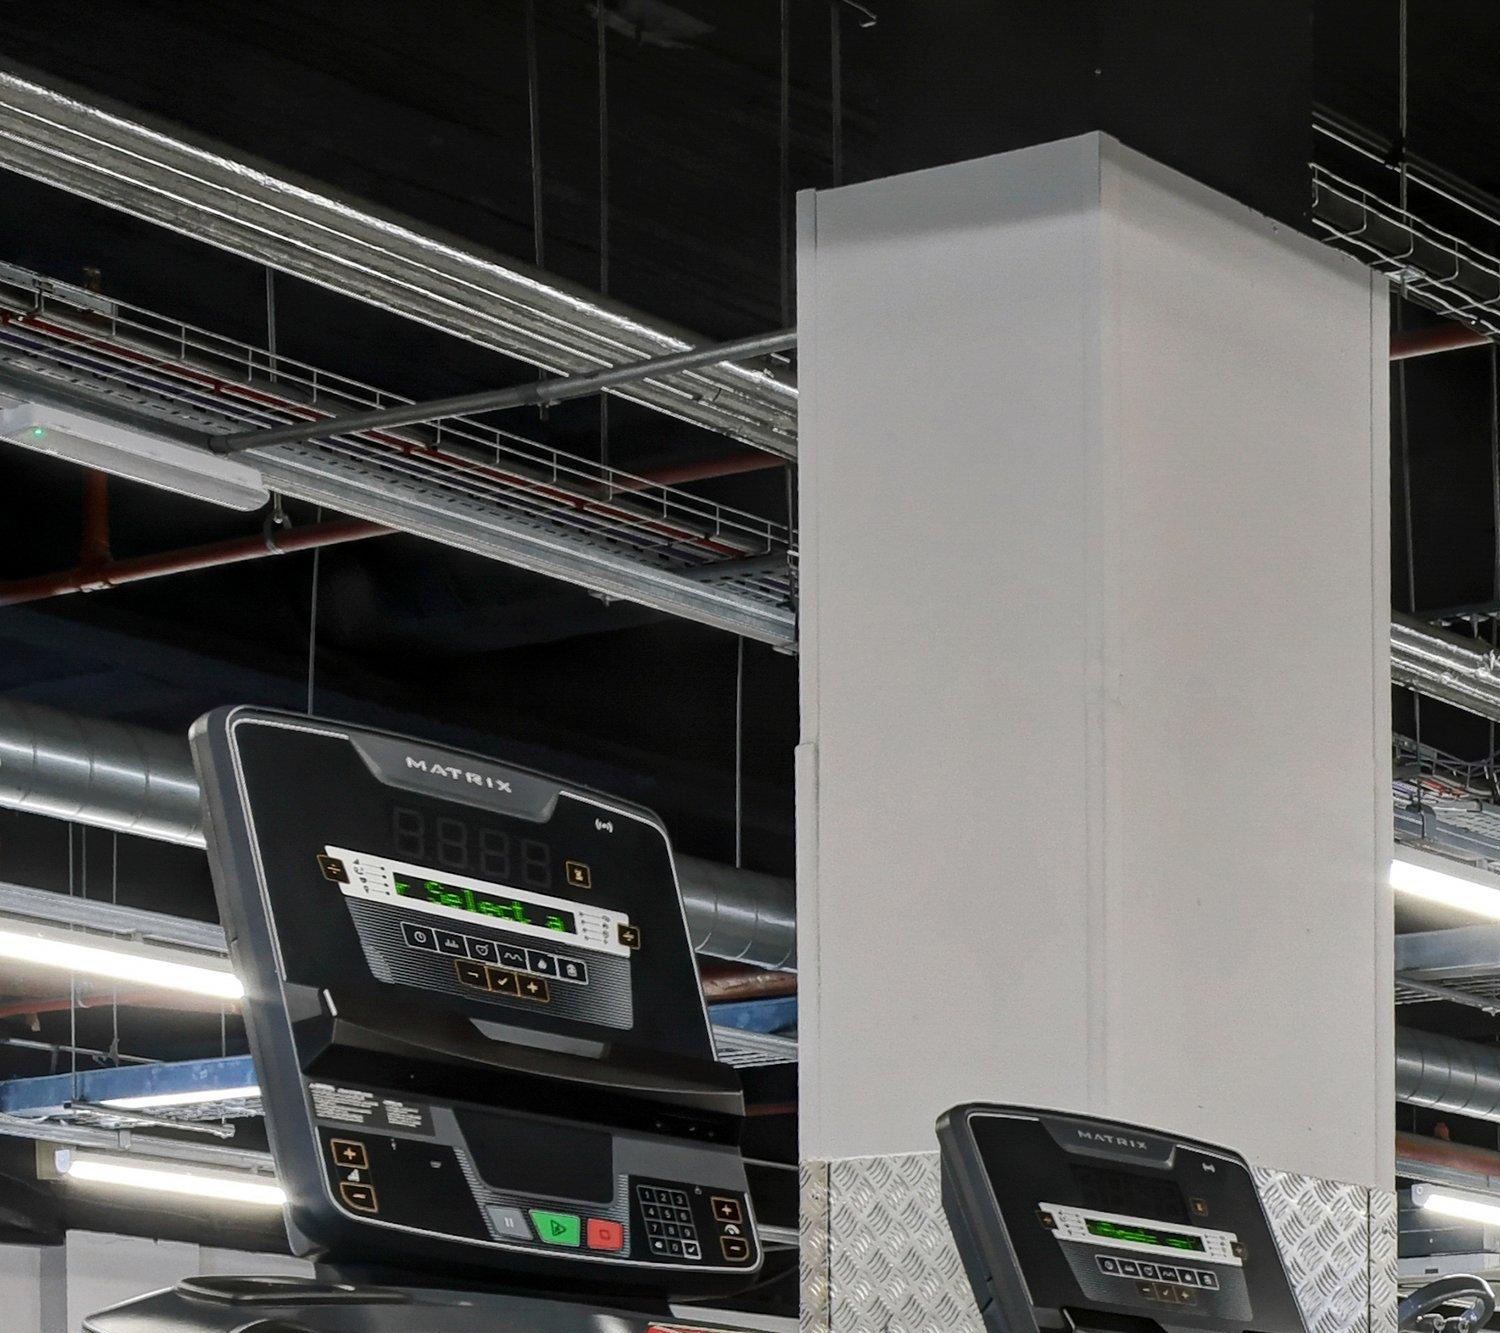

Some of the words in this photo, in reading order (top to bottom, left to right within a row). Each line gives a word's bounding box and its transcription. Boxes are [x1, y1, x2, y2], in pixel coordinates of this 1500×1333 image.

[406, 757, 512, 793] MATRIX
[424, 881, 532, 925] Select
[546, 914, 566, 932] a
[1077, 1130, 1148, 1150] MATRIX
